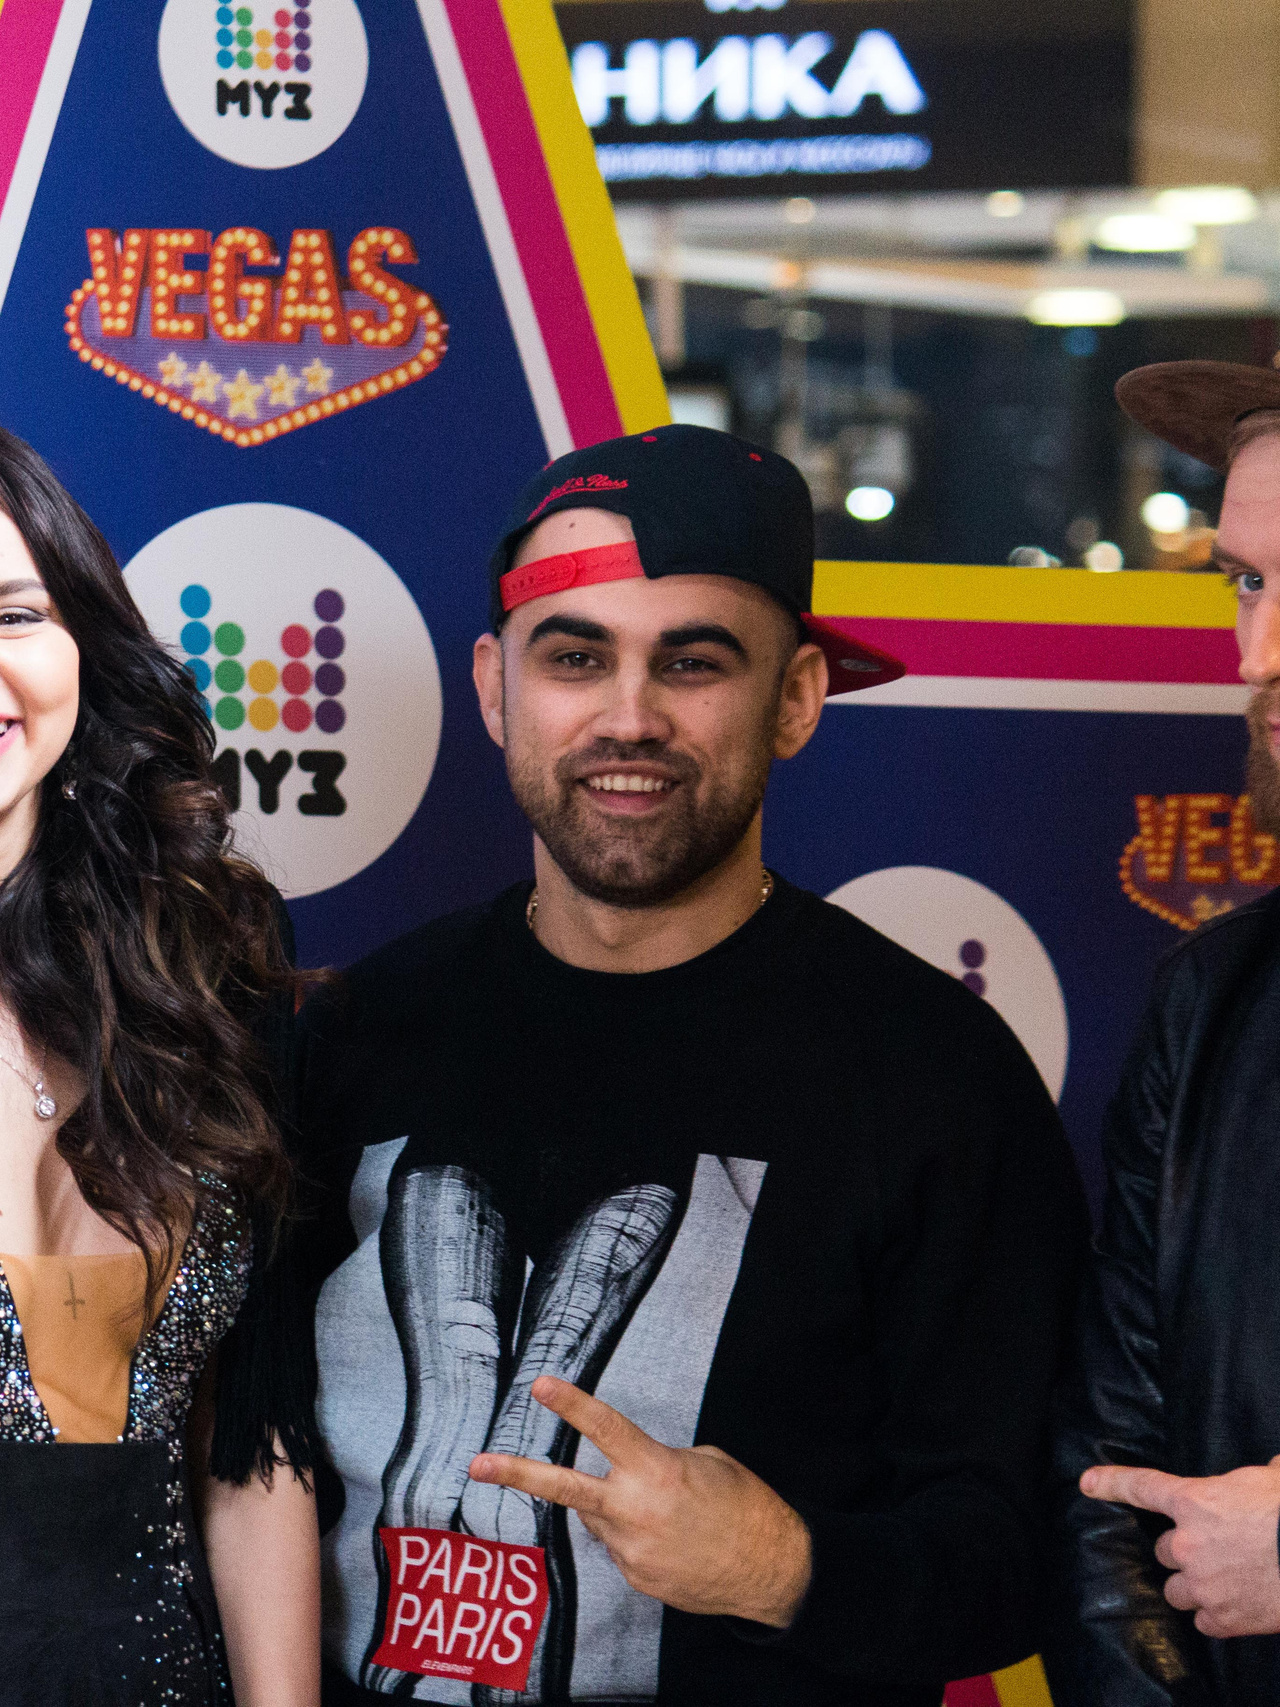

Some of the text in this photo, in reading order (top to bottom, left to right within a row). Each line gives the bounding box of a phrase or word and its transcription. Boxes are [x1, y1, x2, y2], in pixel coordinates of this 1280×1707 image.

[86, 226, 426, 348] VEGAS
[397, 1535, 538, 1606] PARIS
[389, 1592, 533, 1666] PARIS
